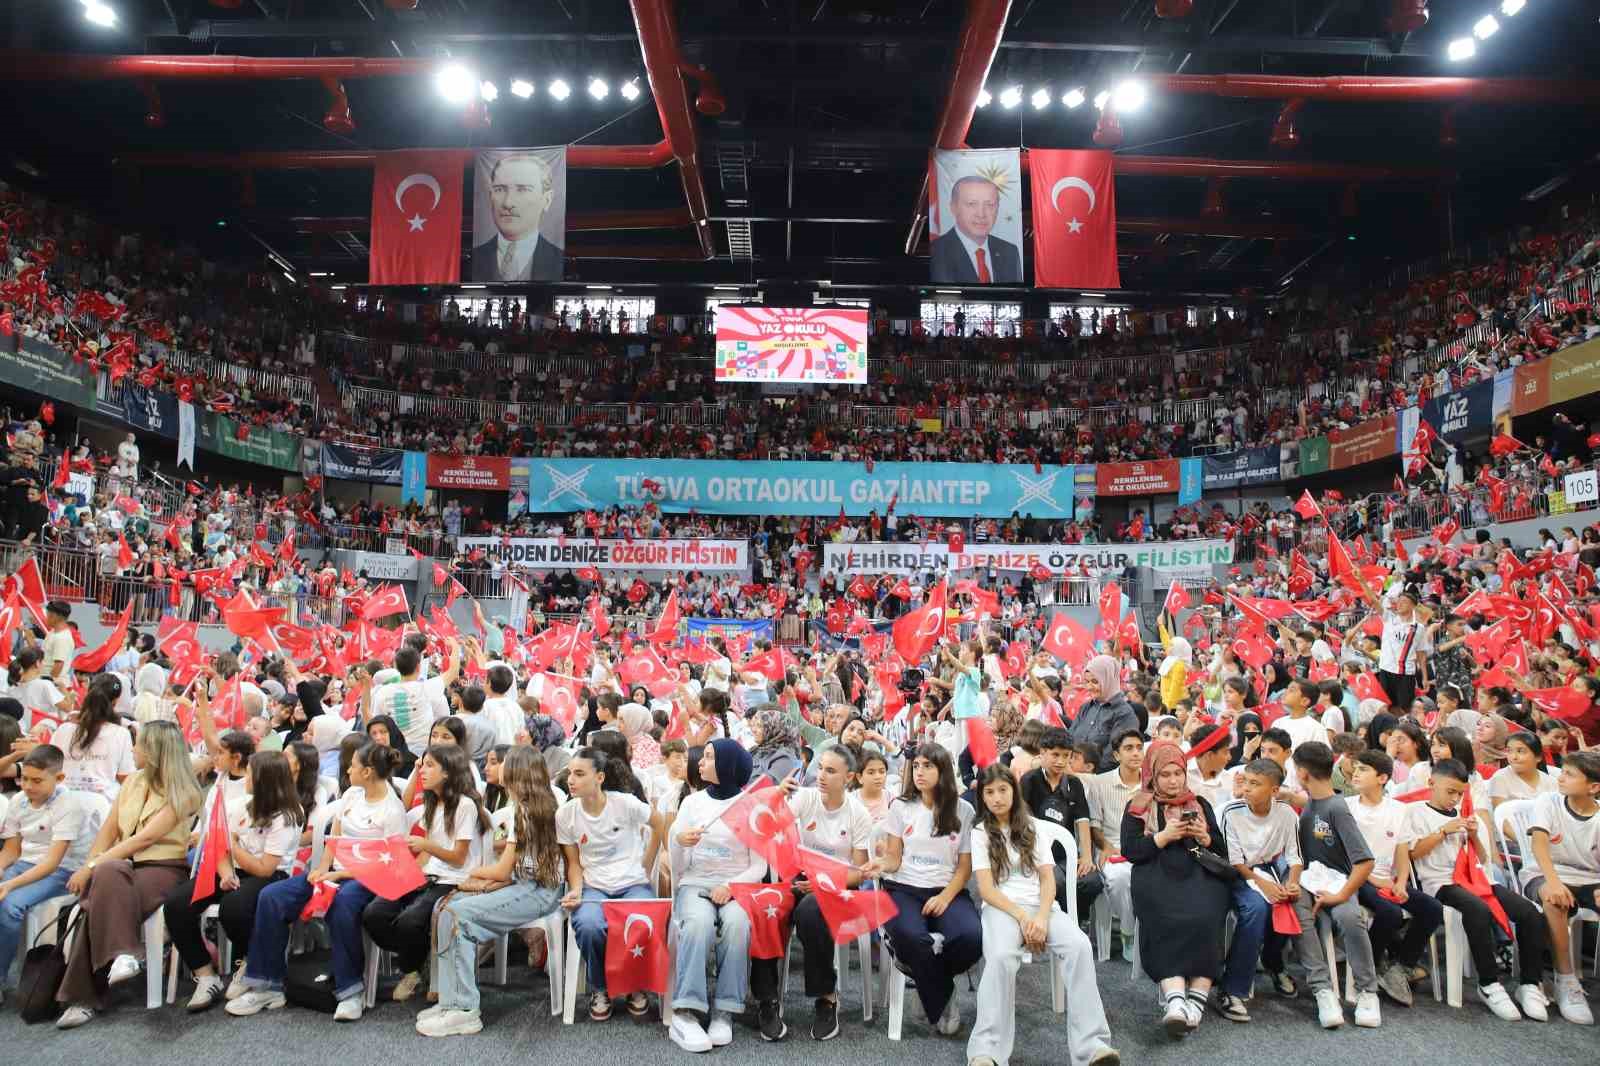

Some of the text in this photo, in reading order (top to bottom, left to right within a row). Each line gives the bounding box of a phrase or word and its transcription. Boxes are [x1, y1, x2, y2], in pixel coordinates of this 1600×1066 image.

[1443, 397, 1469, 421] YAZ
[706, 476, 843, 503] ORTAOKUL
[851, 473, 991, 504] GAZİANTEP
[1570, 478, 1593, 497] 105
[550, 541, 609, 563] DENİZE
[611, 540, 669, 564] ÖZGÜR
[671, 543, 738, 565] FİLİSTİN
[830, 549, 949, 569] NEHİRDEN
[1136, 545, 1230, 567] FİLİSTİN
